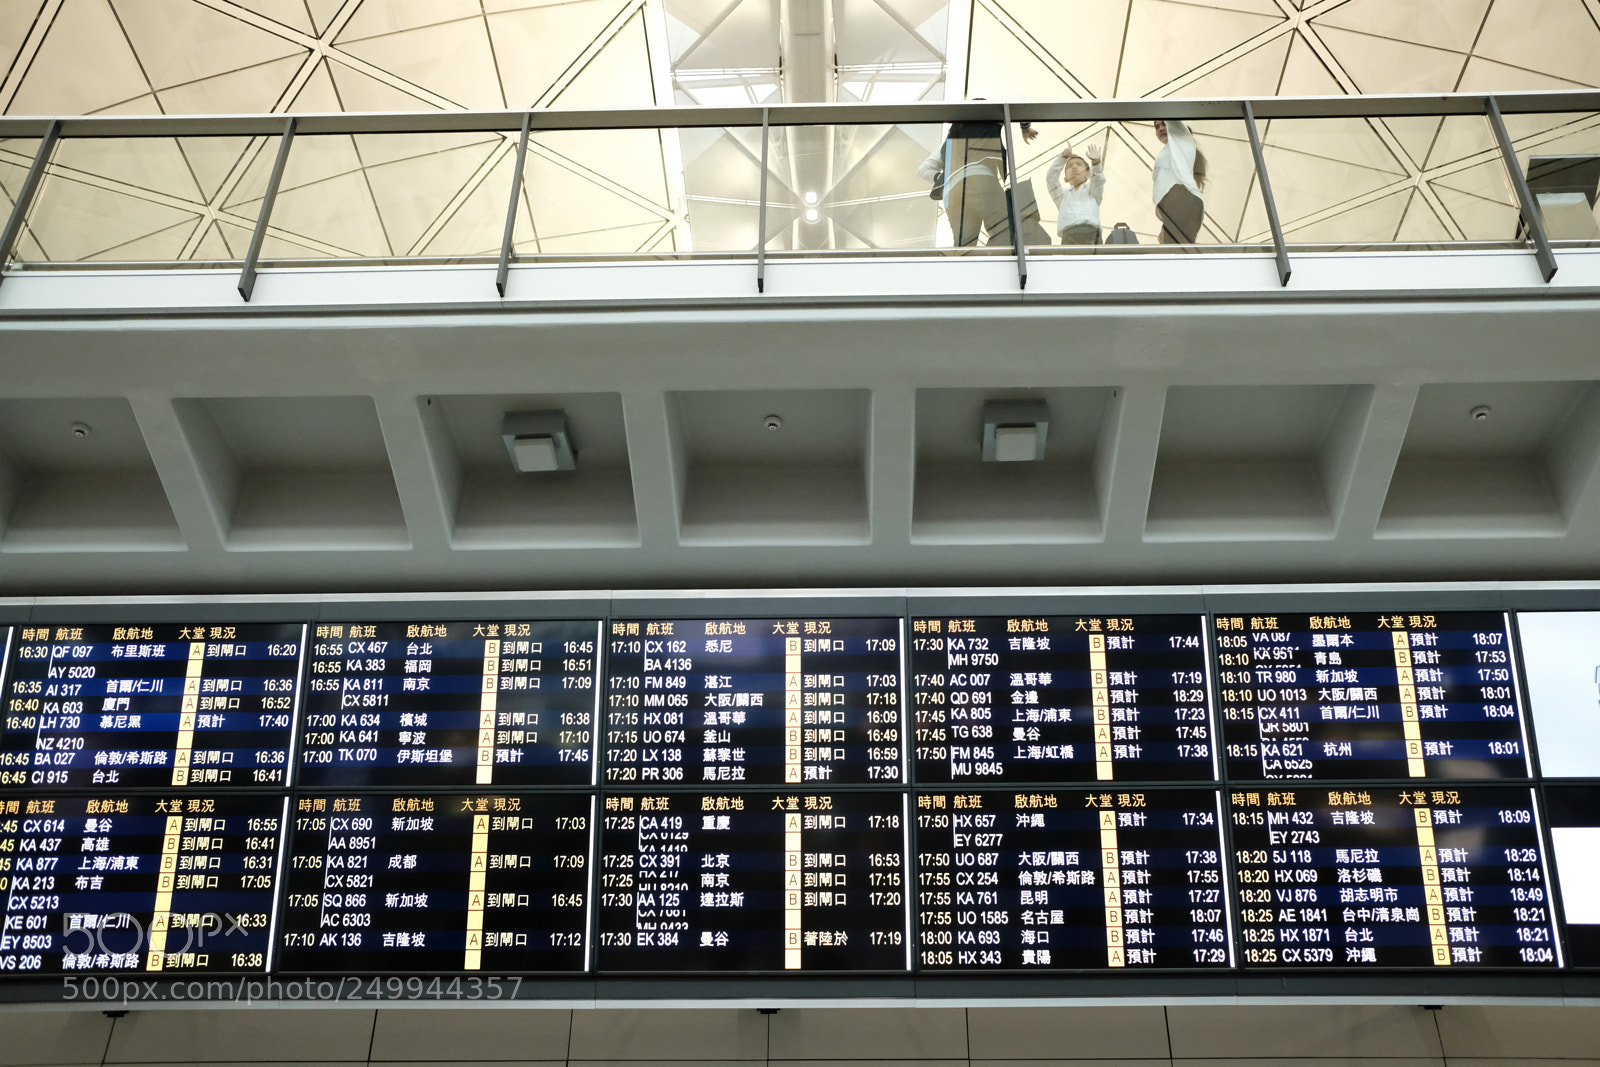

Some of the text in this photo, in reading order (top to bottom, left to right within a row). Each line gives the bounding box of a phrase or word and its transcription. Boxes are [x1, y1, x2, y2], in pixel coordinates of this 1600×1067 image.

[22, 629, 49, 641] 時間
[55, 628, 83, 640] 航班
[179, 627, 205, 640] 大堂
[210, 627, 235, 639] 現況
[315, 641, 593, 655] 16:55 CX 467 台北 B 到閘口 16:45
[915, 671, 1202, 686] 17:40 AC 007 溫哥華 B 預計 17:19
[1221, 668, 1508, 683] 18:10 TR 980 新加坡 A 預計 17:50
[13, 679, 292, 696] 16:35 AI 317 首爾/仁川 A 到閘口 16:36
[1222, 690, 1252, 701] 18:10
[1258, 689, 1276, 701] UO
[1280, 689, 1307, 701] 1013
[1404, 688, 1412, 700] A
[1418, 686, 1446, 700] 預計
[1481, 687, 1510, 699] 18:01
[10, 699, 39, 711] 16:40
[41, 702, 60, 713] KA
[62, 702, 83, 713] 603
[186, 698, 194, 709] A
[200, 697, 240, 709] 到閘口
[262, 697, 290, 709] 16:52
[609, 695, 638, 706] 17:10
[645, 695, 664, 706] MM
[668, 694, 688, 706] 065
[789, 694, 798, 705] A
[804, 693, 844, 706] 到閘口
[867, 693, 896, 704] 17:18
[916, 725, 1206, 741] 17:45 TG 638 曼谷 A 預計 17:45
[304, 749, 588, 763] 17:00 TK 070 伊斯坦堡 B 預計 17:45
[607, 766, 898, 780] 17:20 PR 306 馬尼拉 A 預計 17:30
[606, 797, 633, 811] 時間
[641, 797, 669, 810] 航班
[772, 797, 800, 810] 大堂
[805, 797, 832, 810] 現況
[24, 818, 277, 833] CX 614 曼谷 A 到閘口 16:55
[297, 817, 585, 831] 17:05 CX 690 新加坡 A 到閘口 17:03
[16, 856, 272, 870] KA 877 上海/浦東 B 到閘口 16:31
[603, 853, 900, 868] 17:25 CX 391 北京 B 到閘口 16:53
[919, 853, 949, 866] 17:50
[956, 853, 974, 866] UO
[978, 853, 999, 865] 687
[1106, 853, 1115, 863] B
[1121, 850, 1149, 865] 預計
[1186, 851, 1217, 863] 17:38
[1236, 848, 1536, 863] 18:20 5J 118 馬尼拉 A 預計 18:26
[284, 932, 581, 947] 17:10 AK 136 吉隆坡 A 到閘口 17:12
[601, 933, 631, 945] 17:30
[637, 933, 654, 945] EK
[658, 932, 678, 946] 384
[700, 932, 729, 946] 曼谷
[788, 932, 798, 944] B
[870, 932, 901, 945] 17:19
[921, 928, 1223, 944] 18:00 KA 693 海口 B 預計 17:46
[1243, 927, 1548, 942] 18:25 HX 1871 台北 A 預計 18:21
